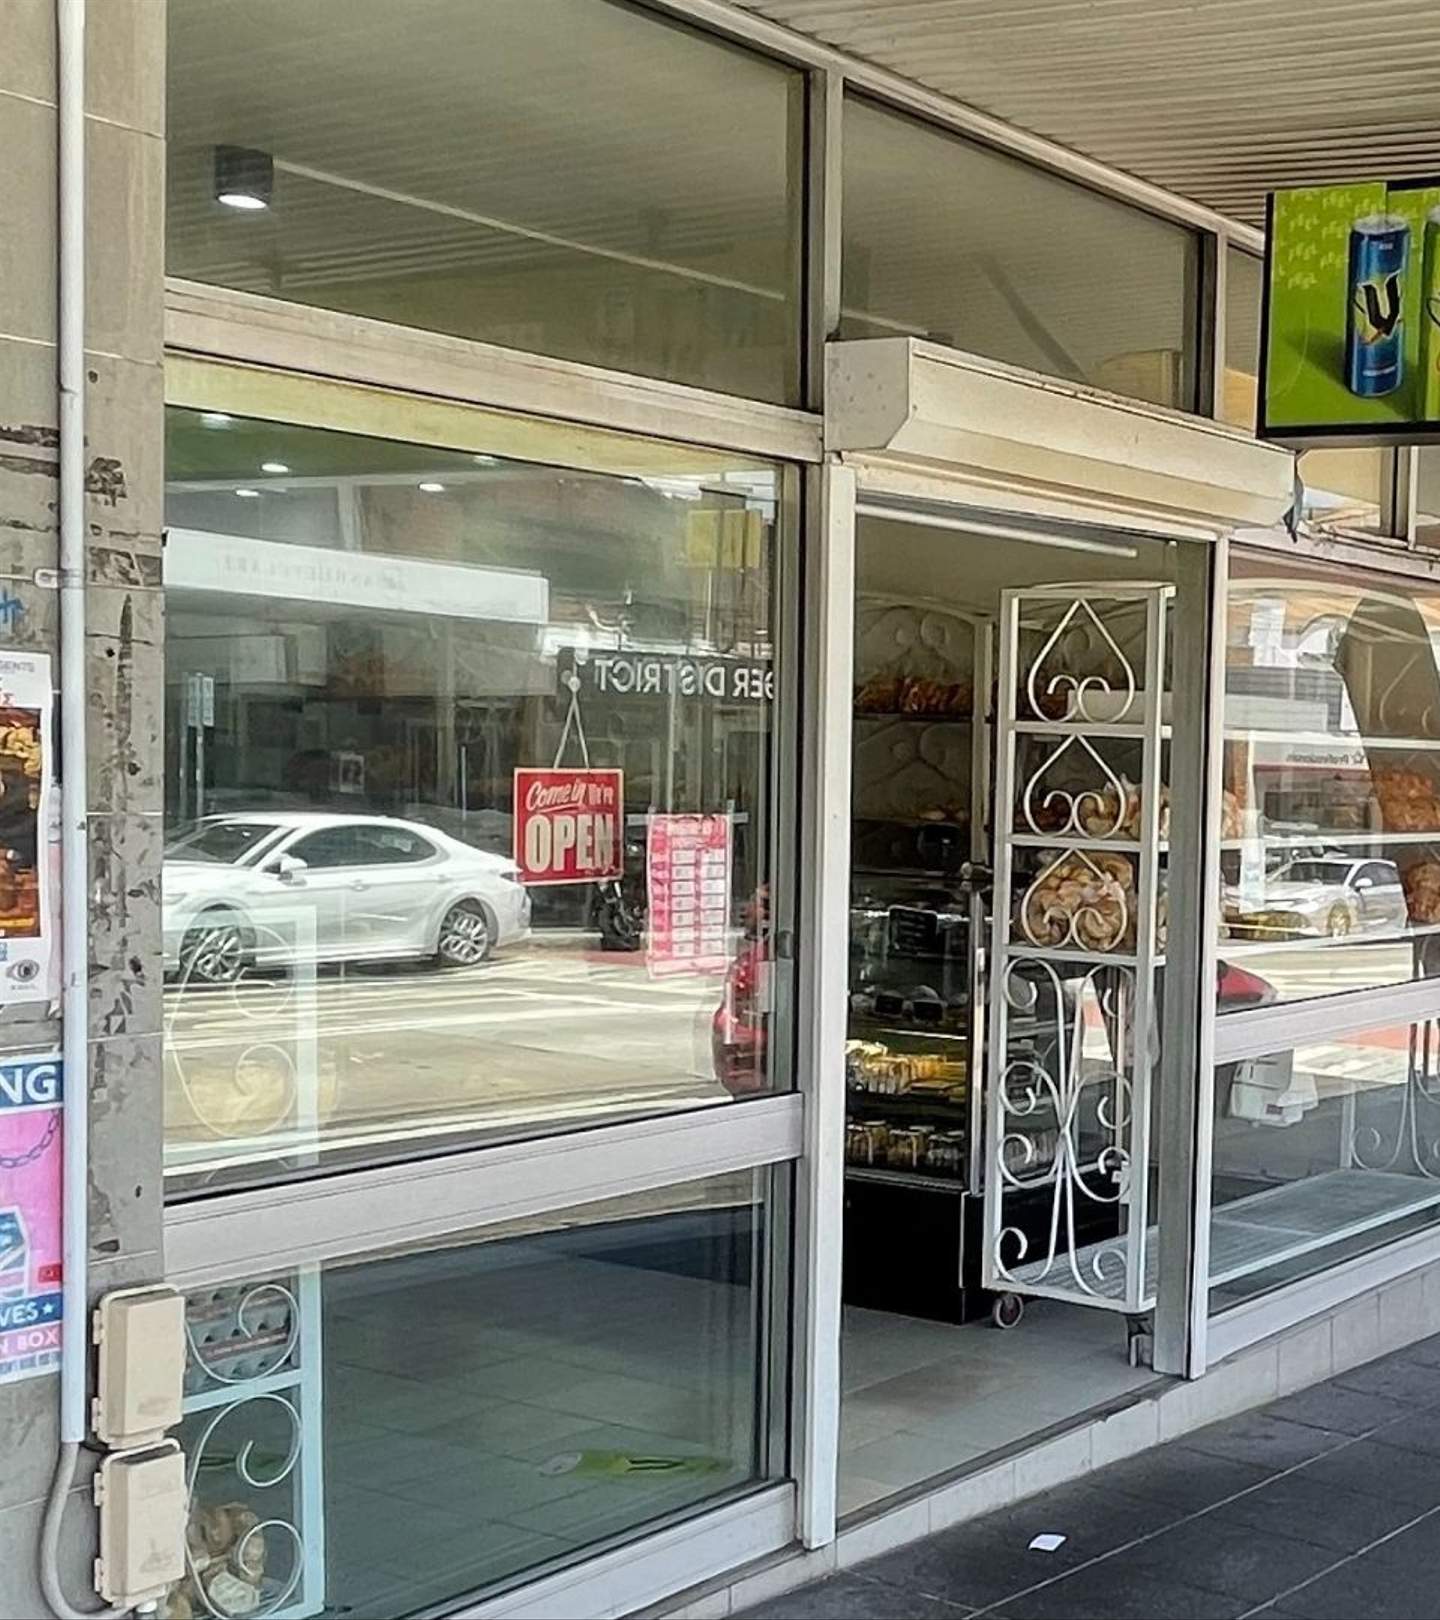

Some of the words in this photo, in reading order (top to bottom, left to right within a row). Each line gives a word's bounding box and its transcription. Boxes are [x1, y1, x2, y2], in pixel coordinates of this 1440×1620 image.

[526, 780, 571, 810] Come
[571, 778, 588, 806] in
[525, 812, 614, 874] OPEN
[16, 1327, 59, 1351] BOX
